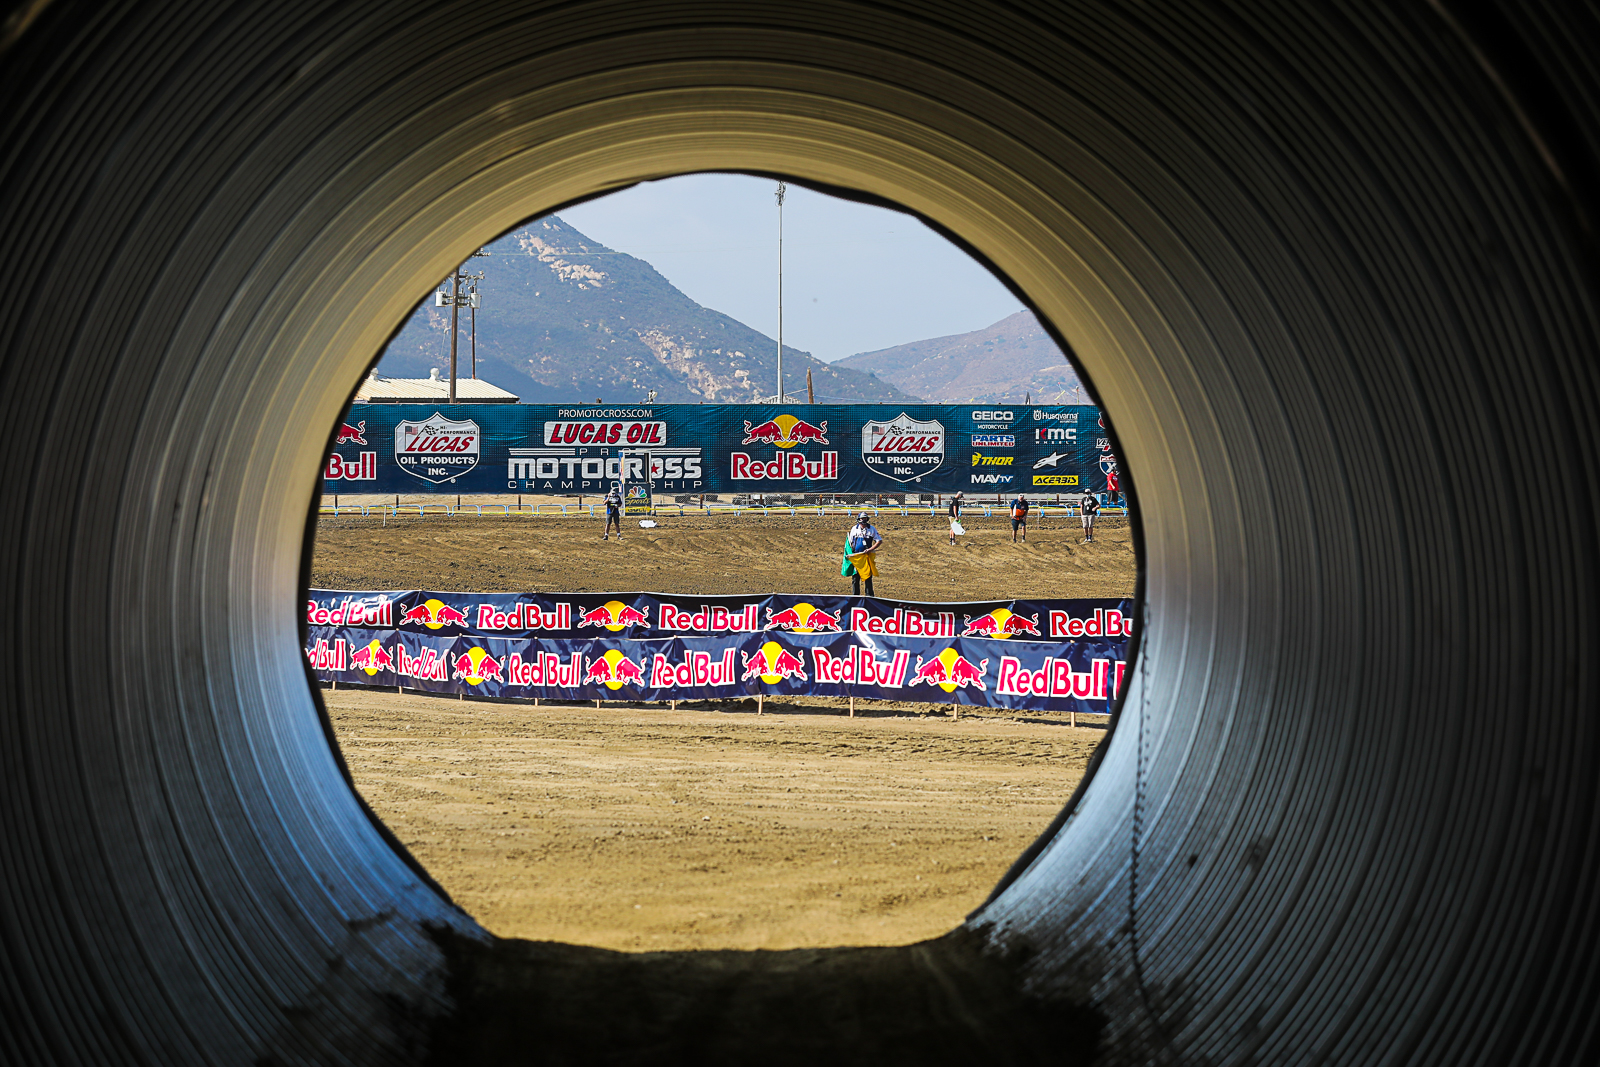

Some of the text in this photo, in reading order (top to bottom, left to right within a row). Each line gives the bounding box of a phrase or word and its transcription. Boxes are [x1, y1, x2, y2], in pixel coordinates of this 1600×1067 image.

[558, 409, 653, 418] PROMOTOCROSS.COM
[972, 411, 1014, 420] GEICO
[1042, 412, 1078, 420] Husqvarna
[405, 436, 474, 452] LUCAS
[550, 423, 662, 444] LUCAS OIL
[872, 436, 939, 452] LUCAS
[400, 456, 476, 465] OIL PRODUCTS
[508, 458, 702, 479] MOTOCROSS
[731, 451, 838, 480] Red Bull
[867, 456, 940, 464] OIL PRODUCTS
[981, 456, 1014, 465] THOR
[428, 468, 449, 476] INC.
[894, 467, 914, 475] INC.
[1034, 476, 1077, 484] ACERBIS
[507, 480, 702, 489] CHAMPIOSHIP
[347, 600, 393, 627] Bull
[477, 602, 571, 631] Red Bull
[658, 603, 759, 632] Red Bull
[851, 607, 955, 638] Red Bull
[1050, 608, 1133, 638] Red Bu
[317, 639, 346, 672] Bull
[397, 643, 449, 681] Red Bull
[508, 651, 582, 688] Red Bull
[650, 647, 736, 688] Red Bull
[812, 645, 910, 688] Red Bull
[996, 656, 1053, 698] Red
[1050, 658, 1109, 700] Bull
